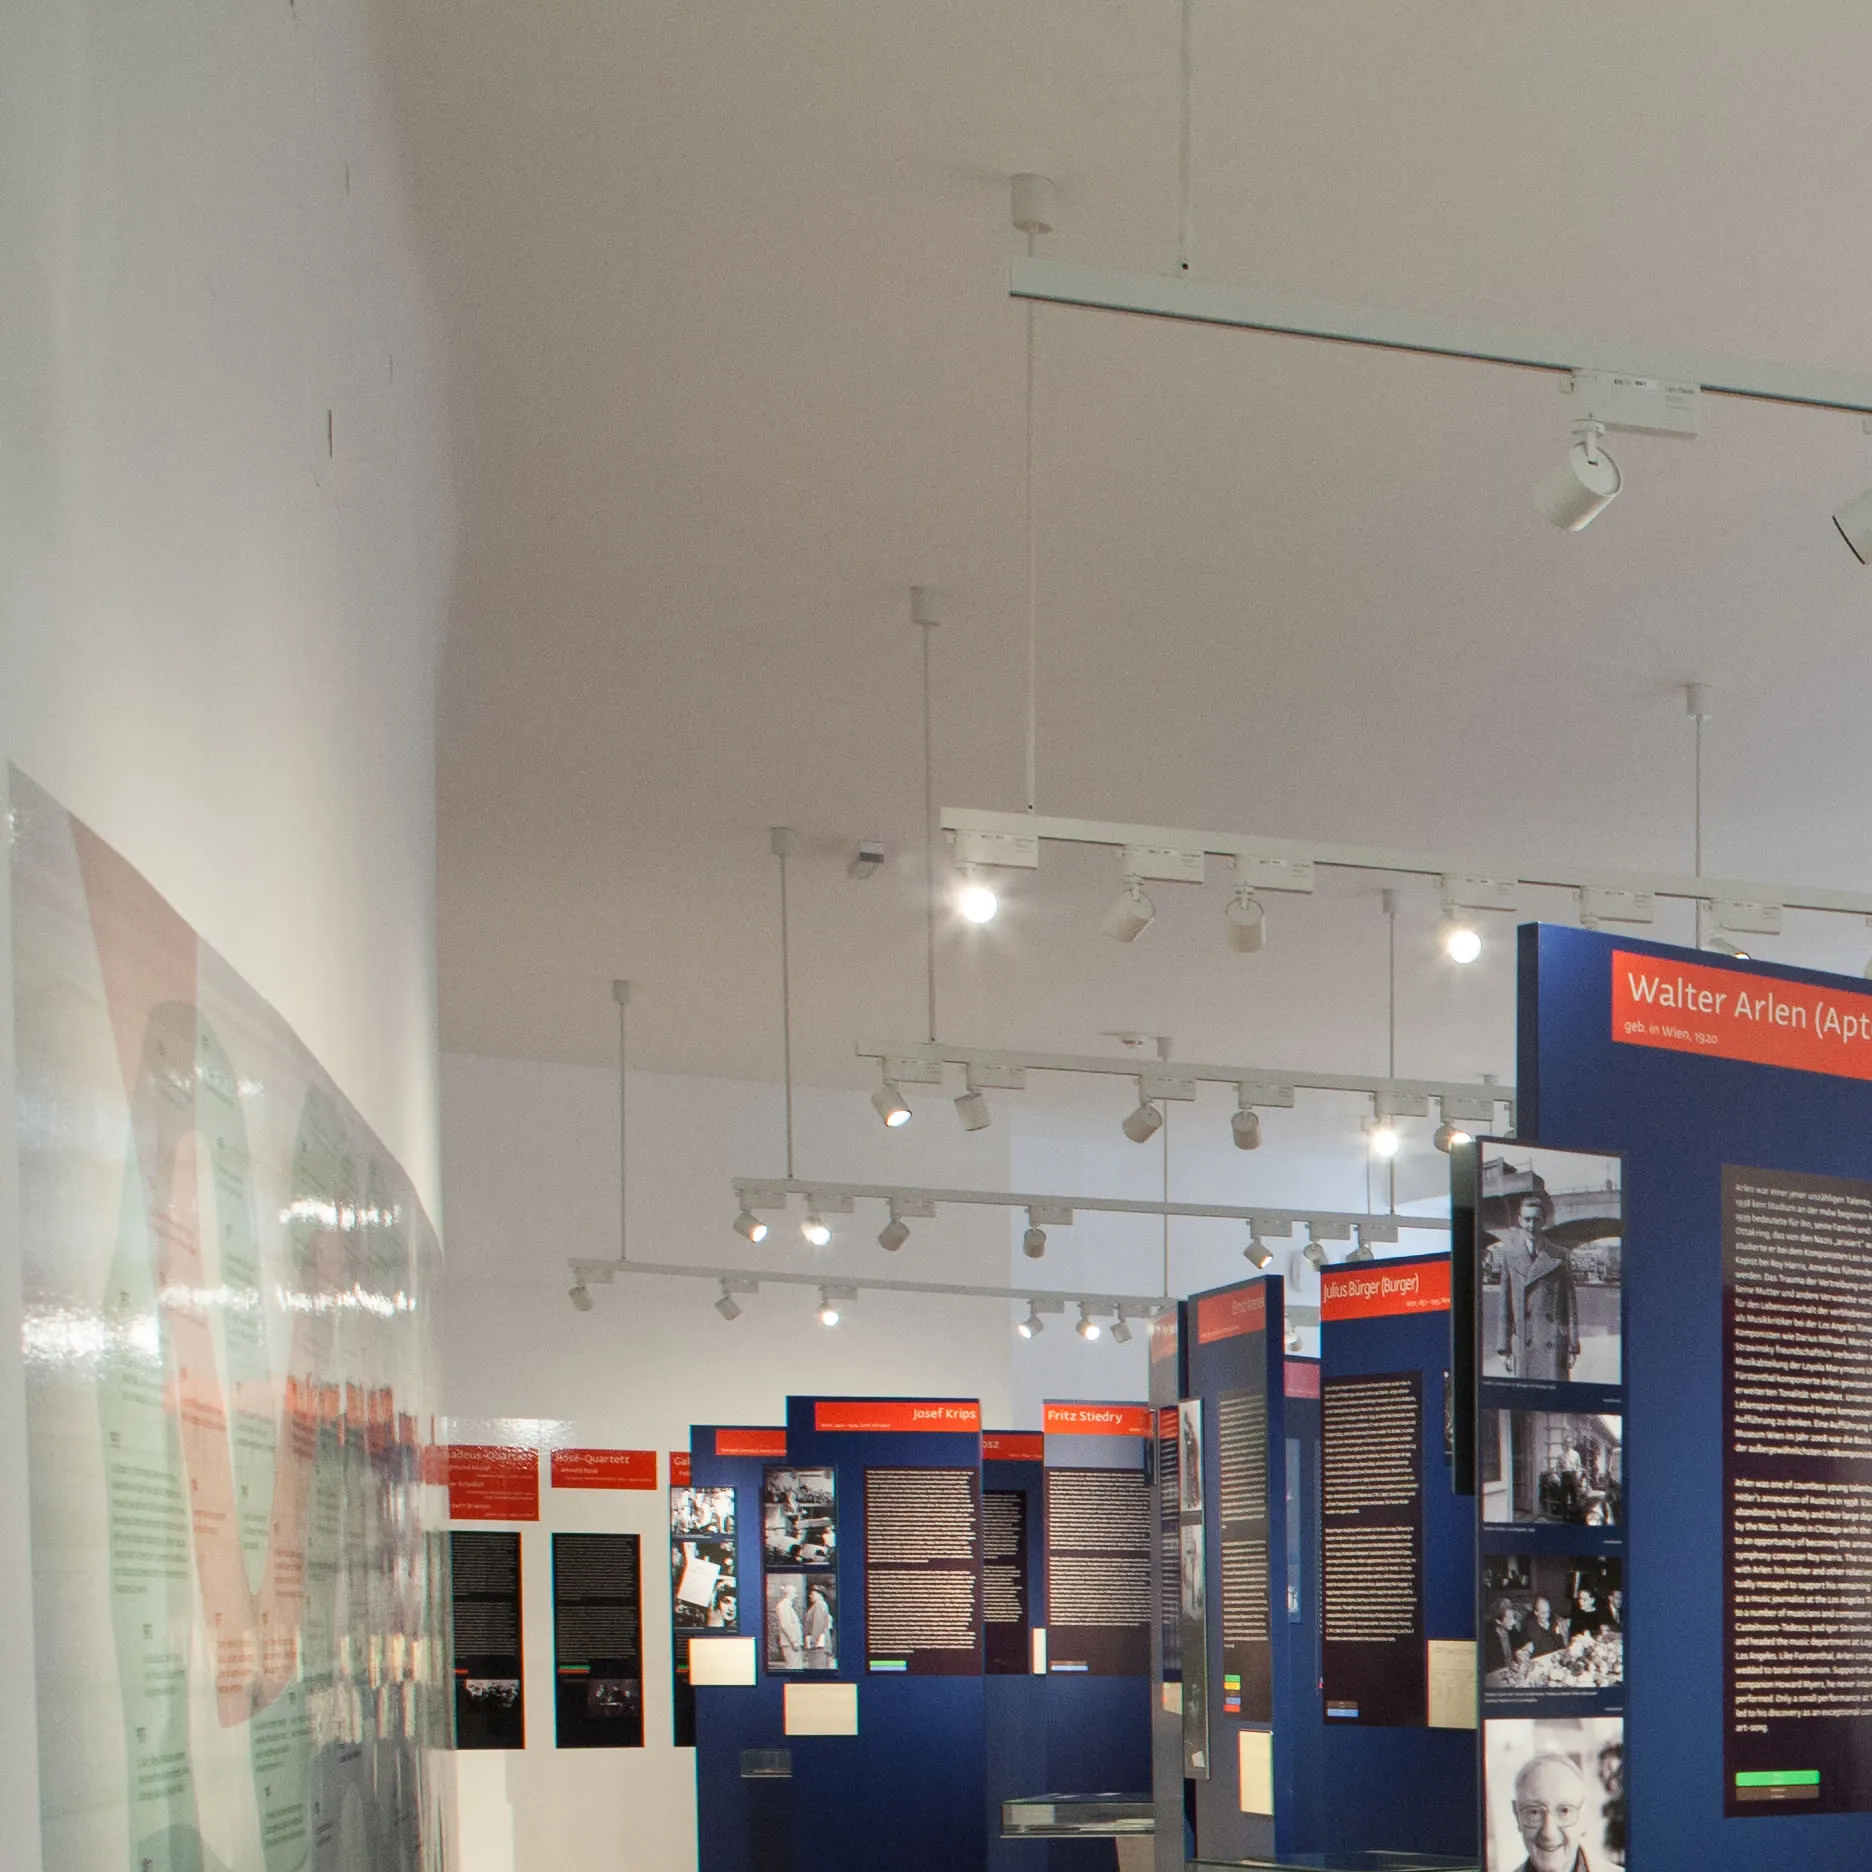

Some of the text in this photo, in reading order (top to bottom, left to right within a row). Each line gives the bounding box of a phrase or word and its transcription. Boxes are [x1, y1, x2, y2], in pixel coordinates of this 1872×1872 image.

[1627, 971, 1727, 1015] Walter
[1733, 991, 1807, 1029] Arlen
[1623, 1019, 1719, 1045] geb. in Wien, 1920
[1323, 1272, 1419, 1302] Julius Bürger (Burger)
[913, 1408, 977, 1421] Josef Krips
[1047, 1410, 1123, 1424] Fritz Stiedry
